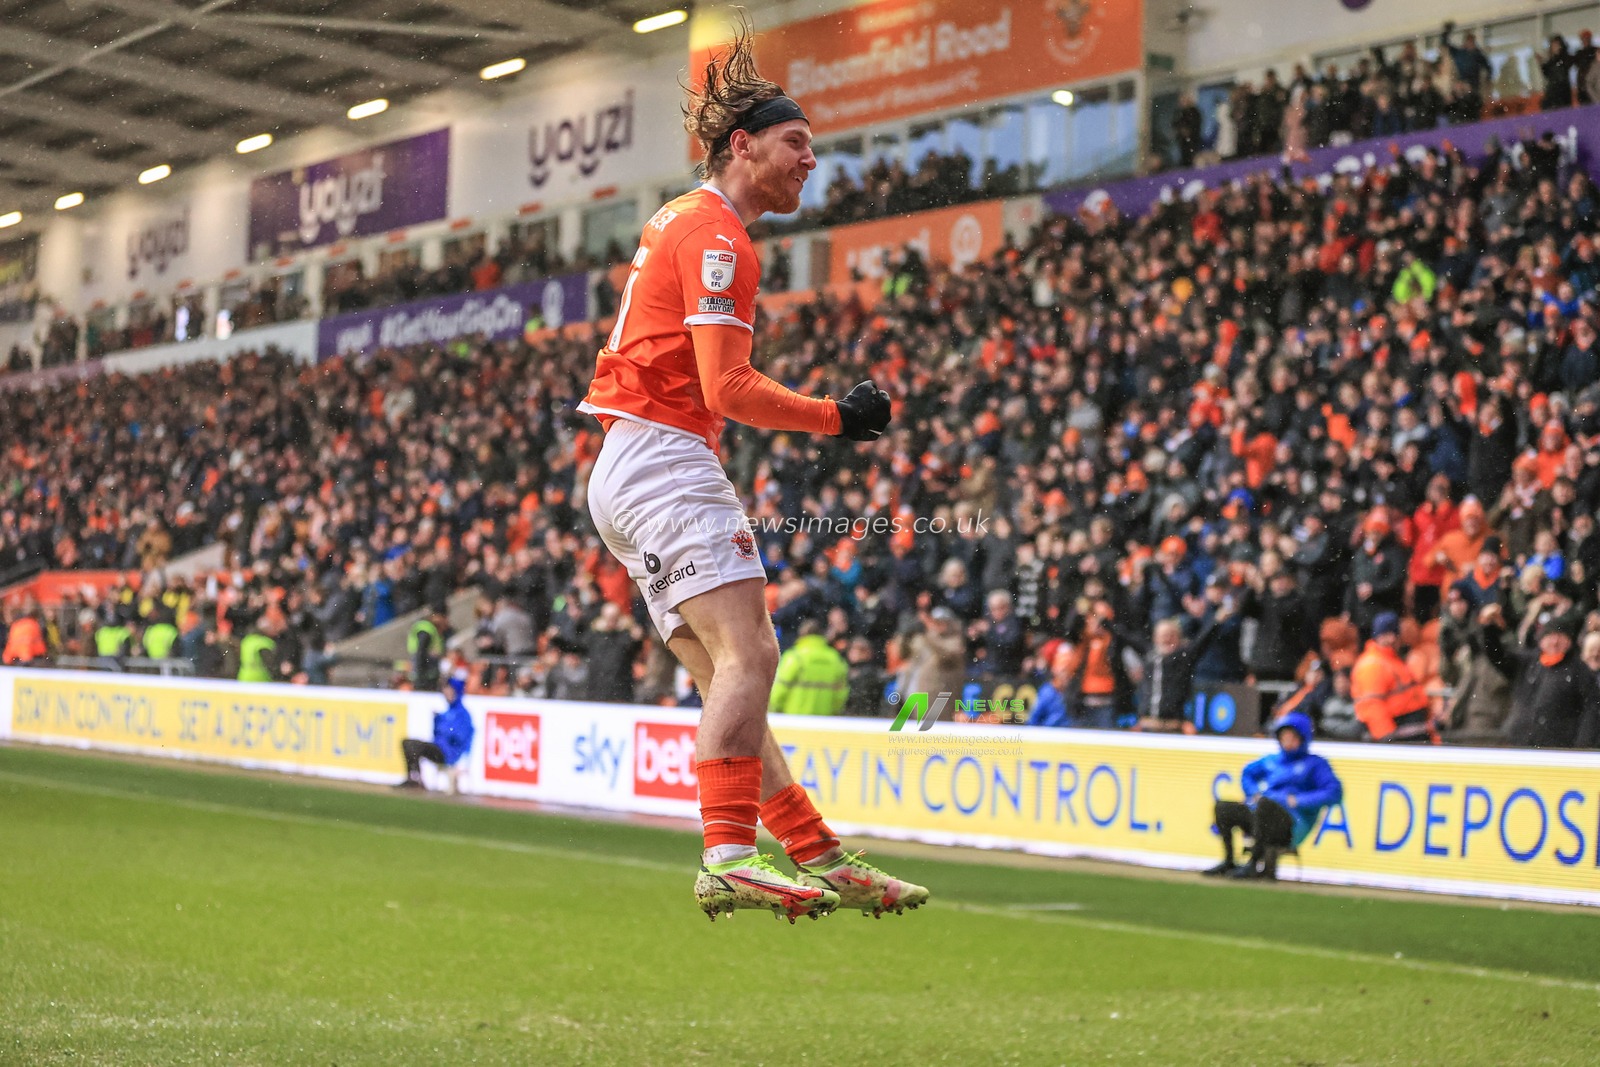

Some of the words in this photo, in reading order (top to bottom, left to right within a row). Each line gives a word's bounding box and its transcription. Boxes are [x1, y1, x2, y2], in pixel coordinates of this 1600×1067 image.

[935, 9, 1011, 64] Road
[706, 253, 718, 261] sky
[719, 254, 733, 262] bet
[699, 296, 712, 305] NOT
[713, 297, 735, 307] TODAY
[708, 304, 722, 312] ANY
[722, 305, 734, 314] DAY
[230, 704, 325, 754] DEPOSIT
[332, 712, 397, 758] LIMIT
[487, 715, 538, 771] bet
[574, 721, 626, 790] sky
[636, 725, 698, 787] bet
[861, 750, 904, 806] IN
[920, 754, 1163, 832] CONTROL.
